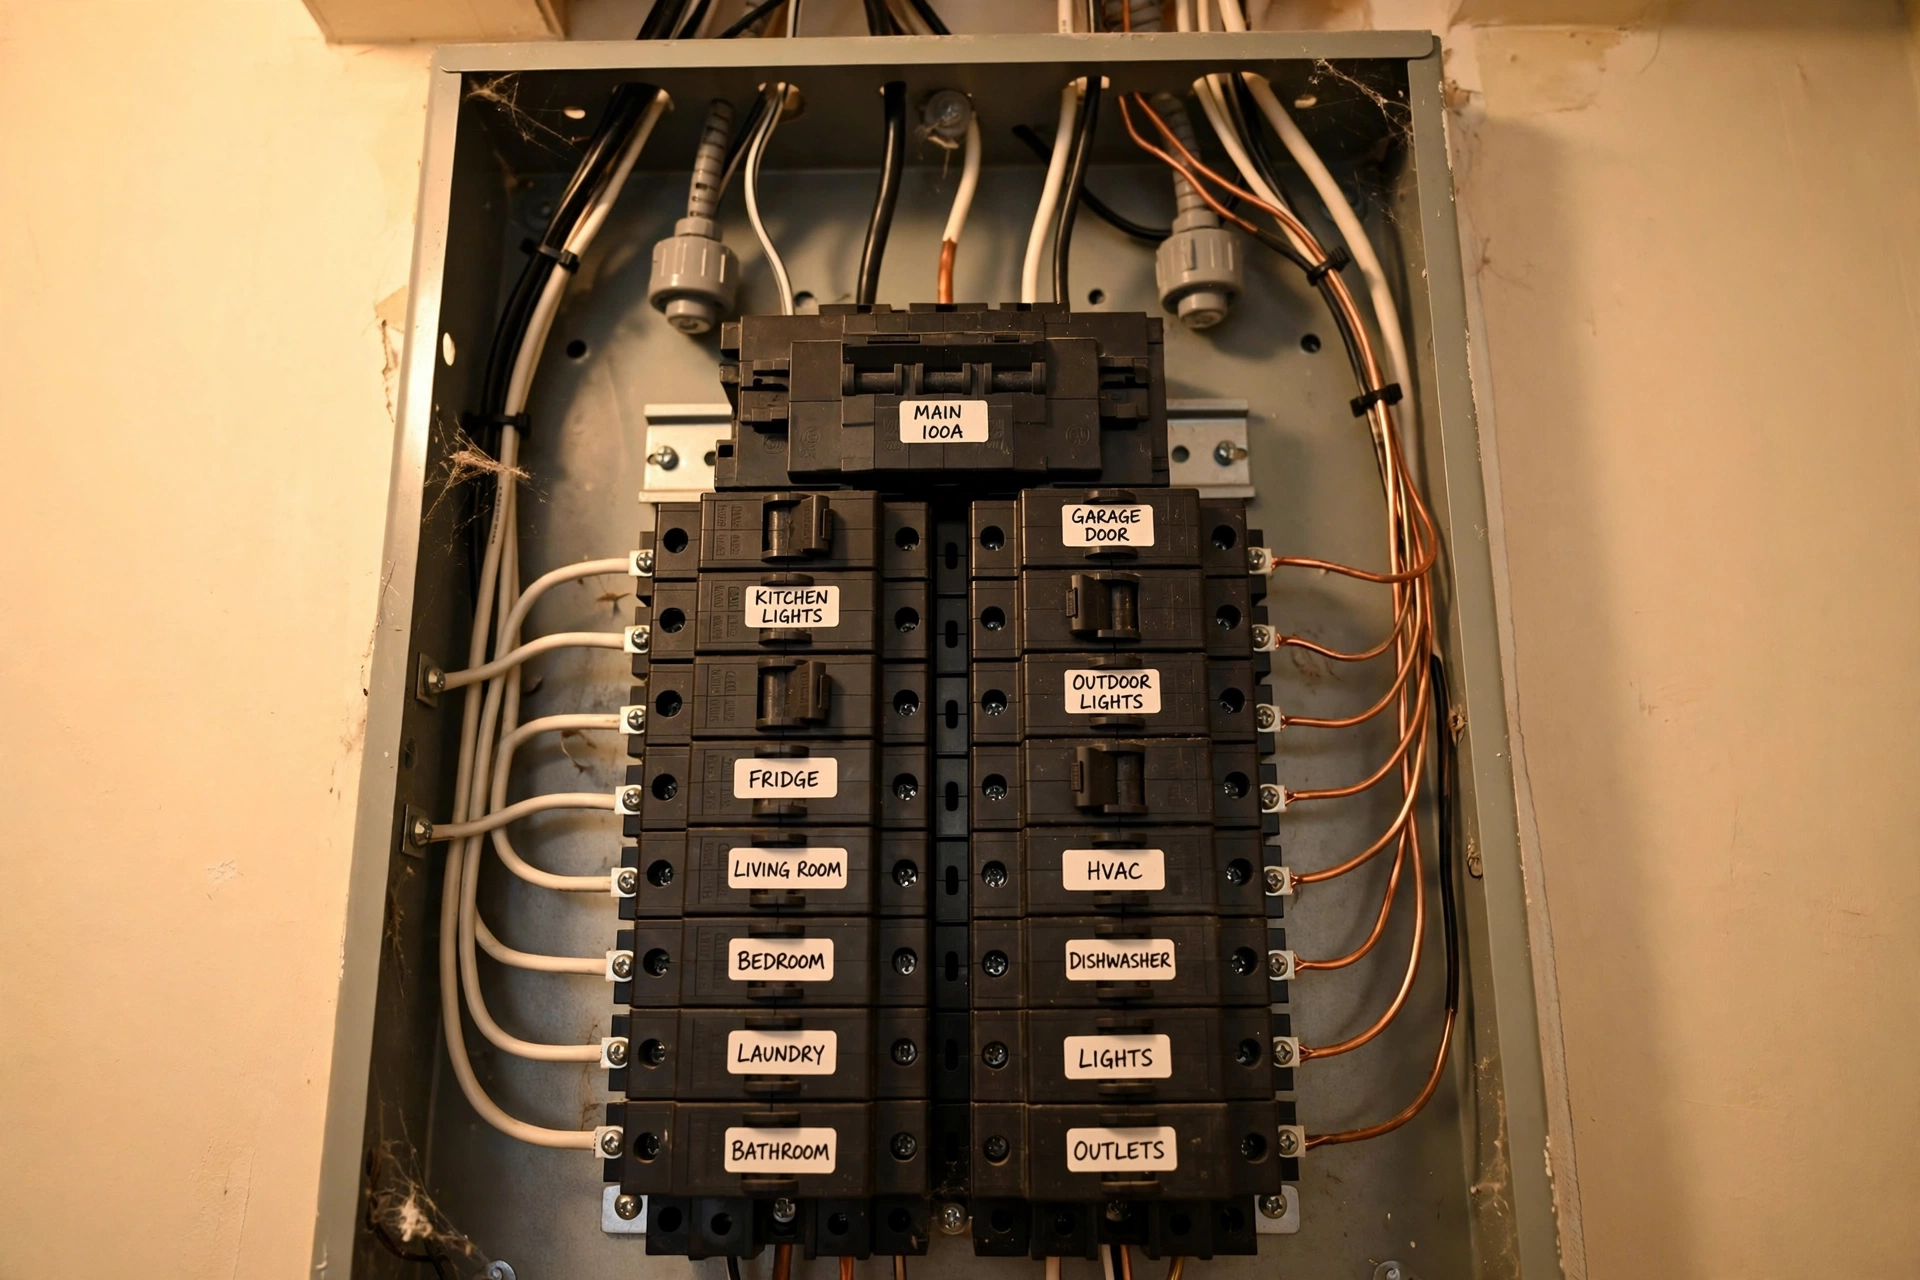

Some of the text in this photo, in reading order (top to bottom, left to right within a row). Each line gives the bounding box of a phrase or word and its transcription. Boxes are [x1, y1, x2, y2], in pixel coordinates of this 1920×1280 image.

[914, 405, 961, 420] MAIN
[923, 424, 963, 440] 100A
[1072, 508, 1141, 524] GARAGE
[1085, 527, 1129, 542] DOOR
[755, 590, 828, 606] KITCHEN
[762, 608, 823, 624] LIGHTS
[1072, 674, 1152, 690] OUTDOOR
[1080, 693, 1143, 710] LIGHTS
[749, 769, 819, 789] FRIDGE
[734, 859, 842, 879] LIVING ROOM
[1087, 860, 1143, 881] HVAC
[737, 950, 825, 971] BEDROOM
[1069, 951, 1172, 970] DISHWASHER
[737, 1043, 825, 1065] LAUNDRY
[1078, 1048, 1153, 1069] LIGHTS
[731, 1139, 830, 1161] BATHROOM
[1073, 1140, 1165, 1161] OUTLETS
